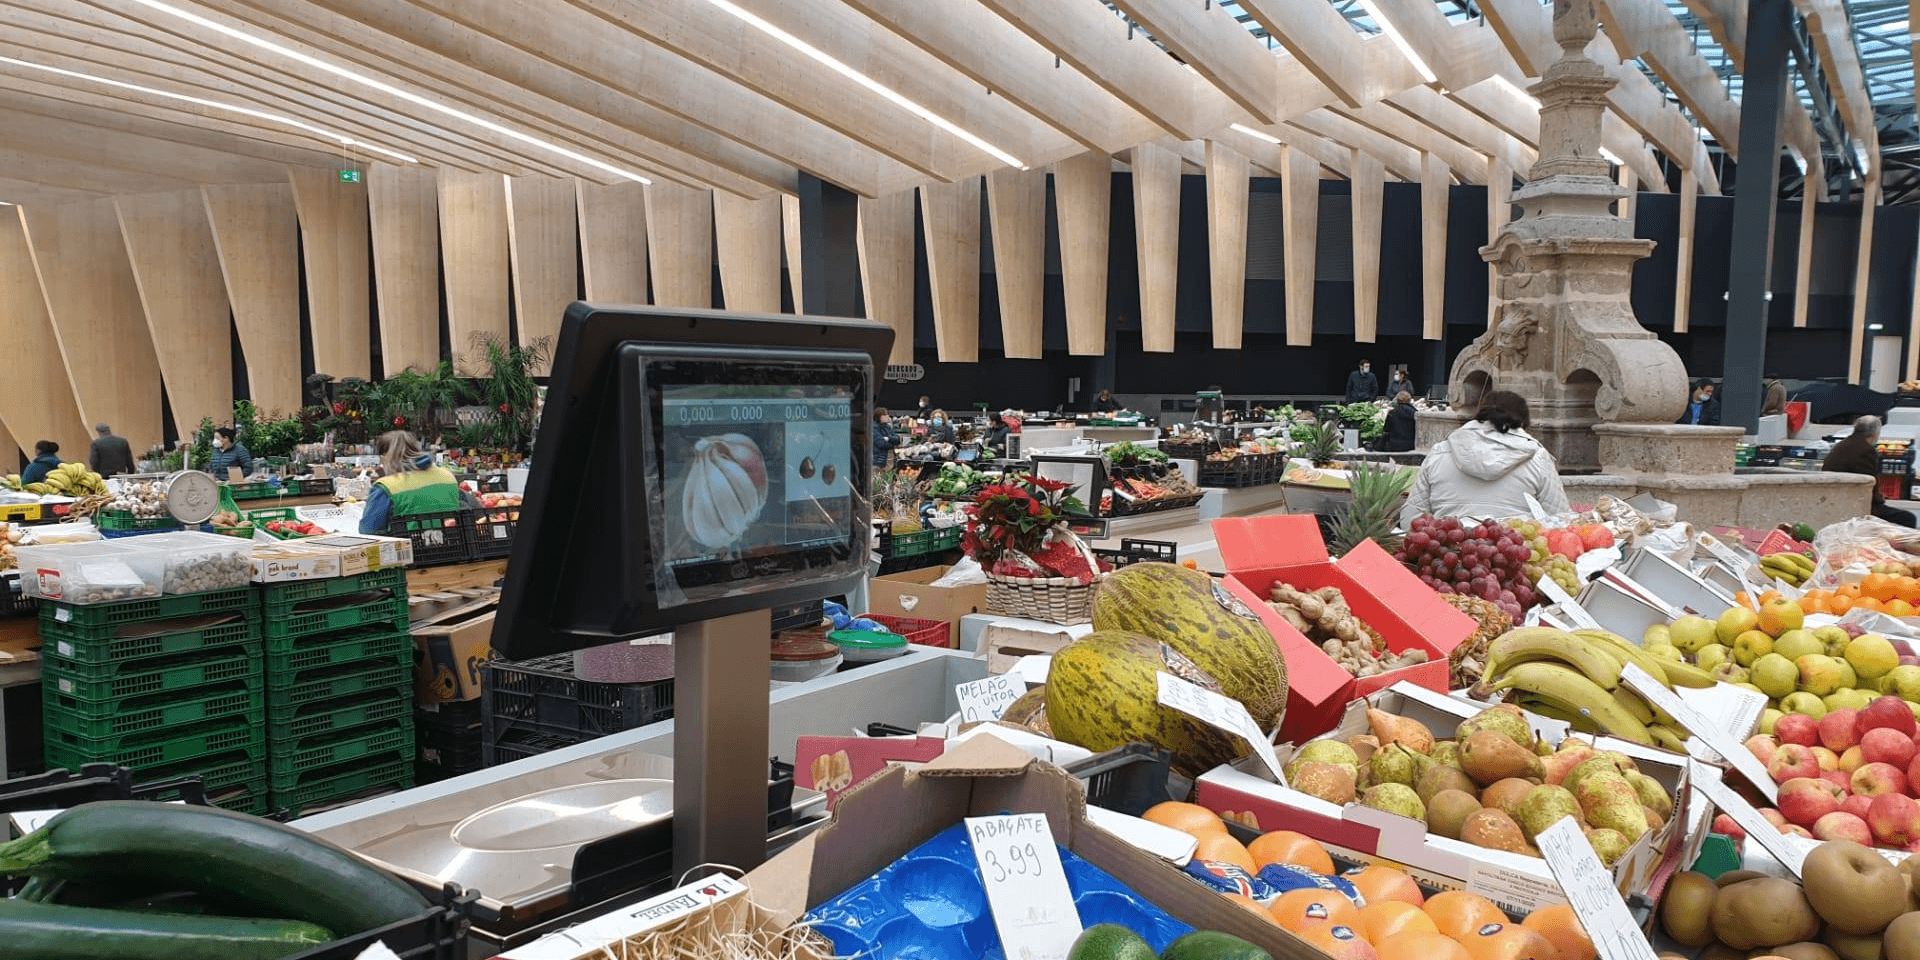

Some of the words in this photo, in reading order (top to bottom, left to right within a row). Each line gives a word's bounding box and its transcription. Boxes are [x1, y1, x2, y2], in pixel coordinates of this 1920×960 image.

[730, 406, 763, 421] 0,000
[785, 405, 808, 420] 0,00
[985, 843, 1042, 882] 3.99
